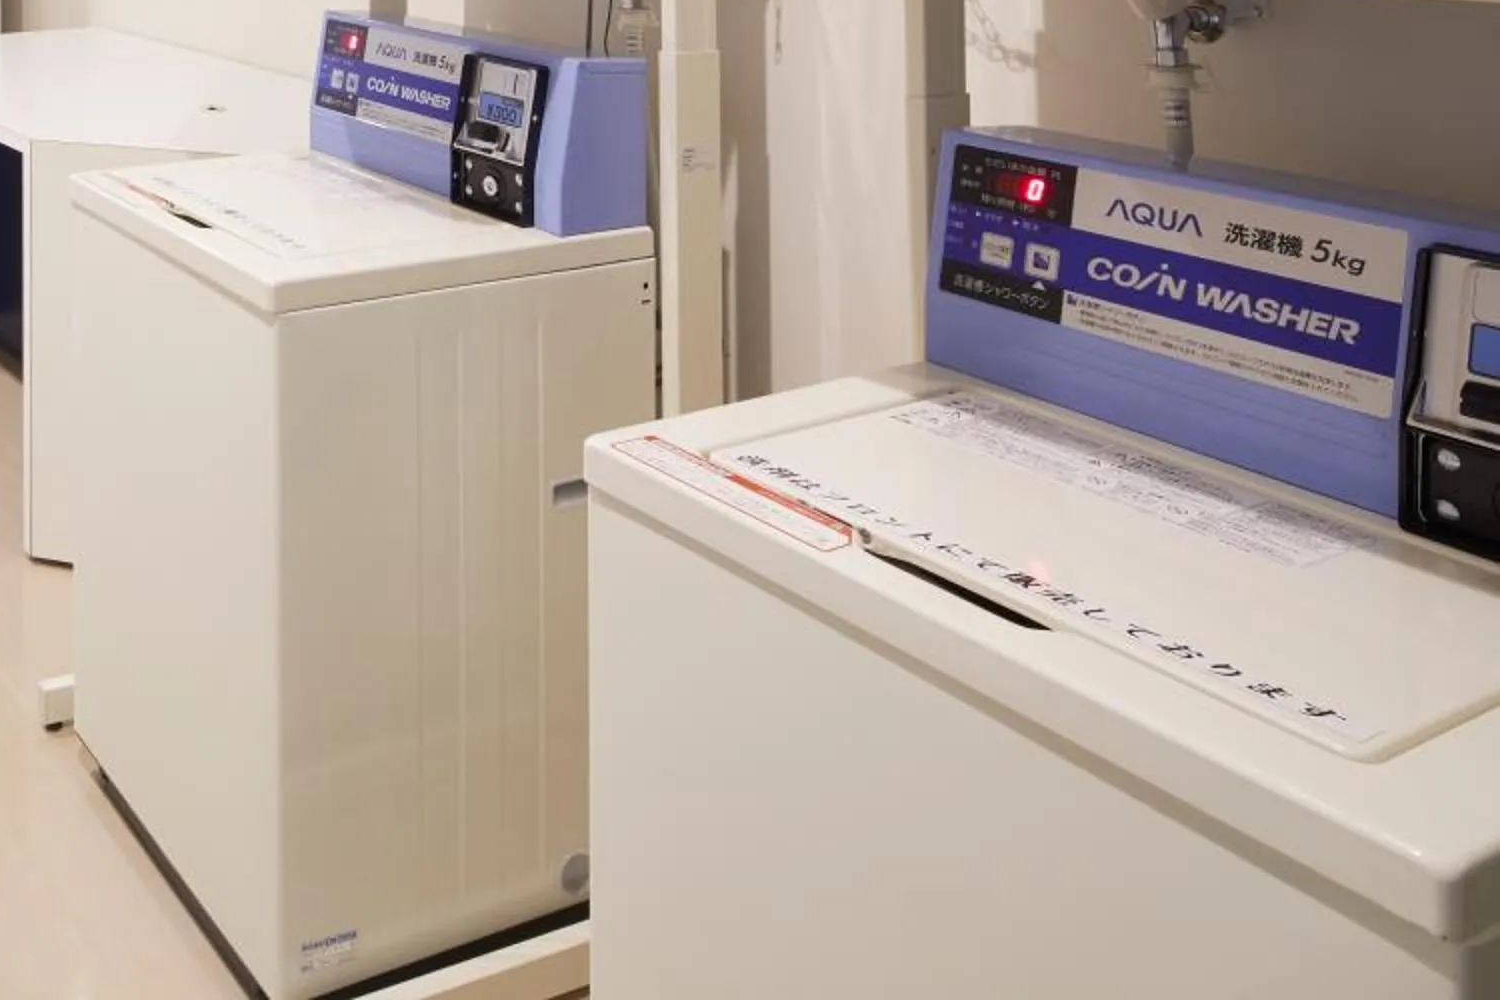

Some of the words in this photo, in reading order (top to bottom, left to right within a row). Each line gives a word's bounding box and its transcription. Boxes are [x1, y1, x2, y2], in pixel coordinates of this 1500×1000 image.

[1025, 178, 1046, 202] 0
[1105, 198, 1203, 238] AQUA
[1223, 220, 1304, 260] 洗濯機
[1310, 239, 1366, 277] 5kg
[1196, 283, 1361, 346] WASHER
